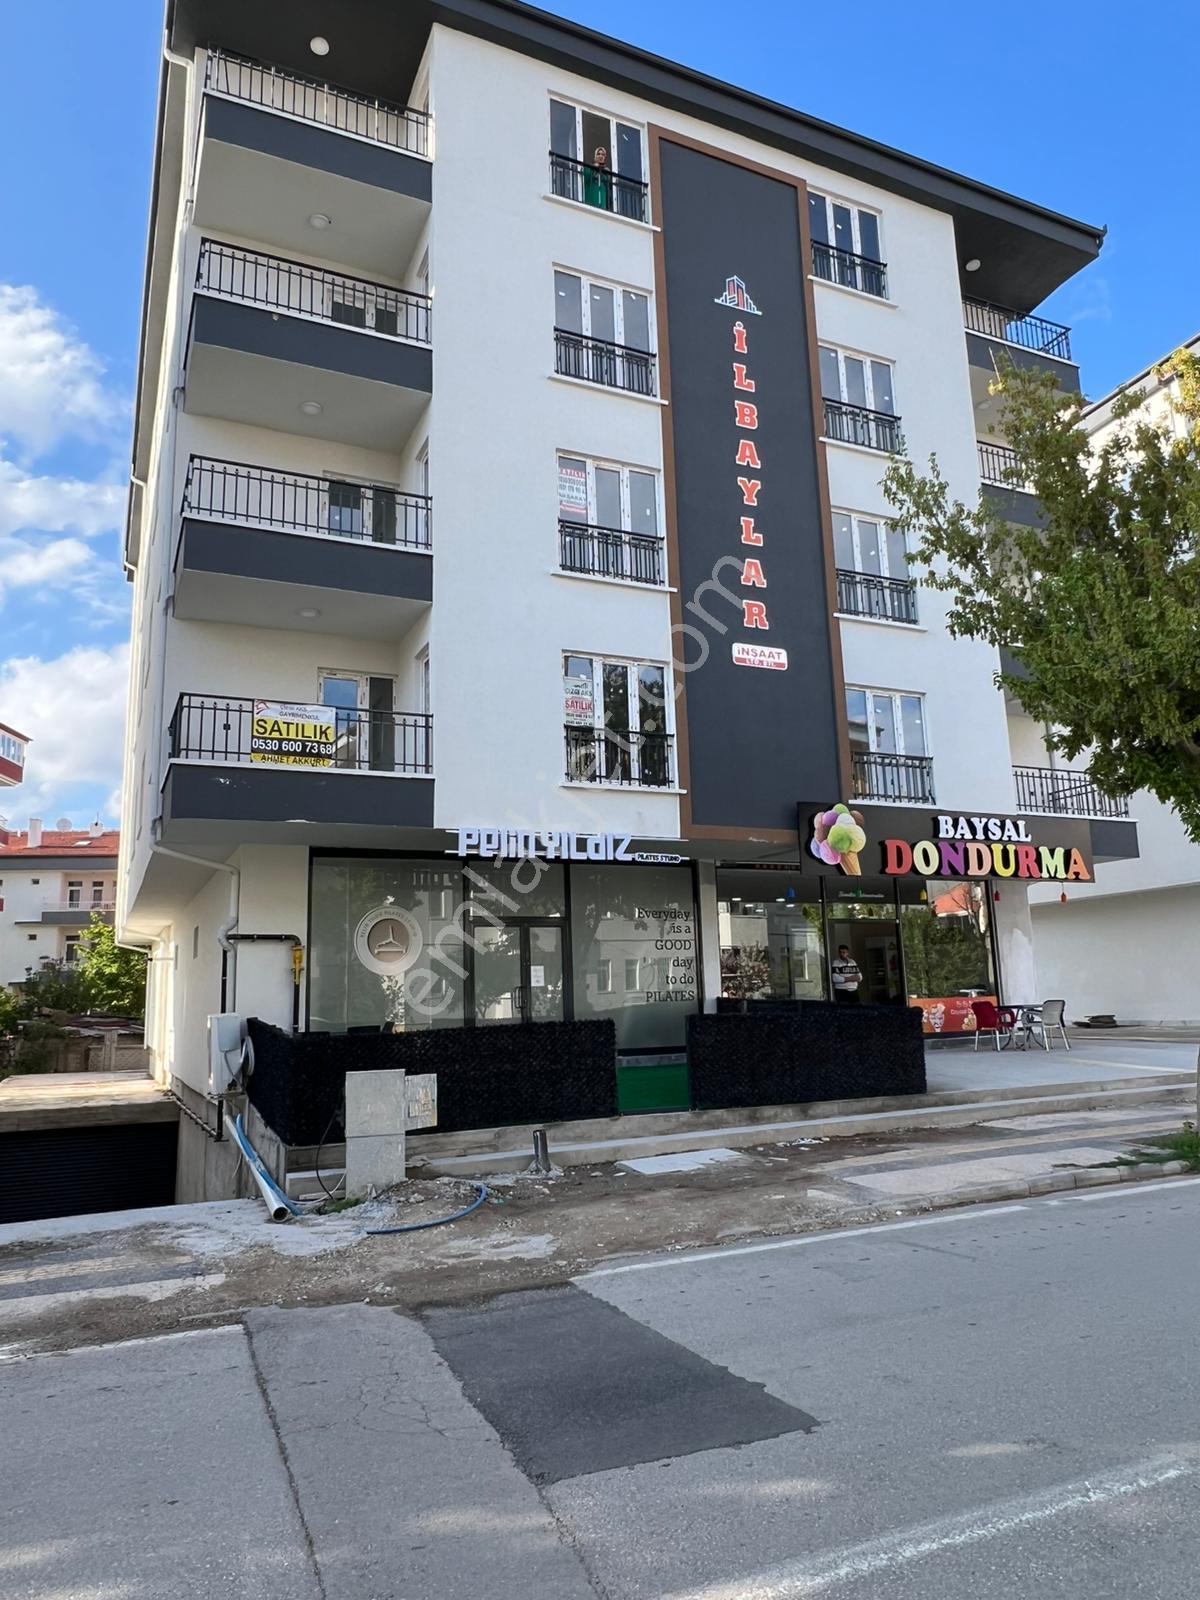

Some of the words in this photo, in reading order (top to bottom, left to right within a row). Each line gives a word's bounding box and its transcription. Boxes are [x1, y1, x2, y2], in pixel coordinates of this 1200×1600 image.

[733, 321, 769, 630] İLBAYLAR
[565, 700, 593, 711] SATILIK
[255, 719, 331, 741] SATILIK
[252, 738, 279, 751] 0530
[282, 741, 302, 752] 600
[305, 742, 318, 753] 73
[320, 744, 332, 755] 68
[937, 815, 1032, 842] BAYSAL
[884, 839, 1091, 880] DONDURMA
[637, 907, 690, 921] Everyday
[672, 923, 682, 933] is
[684, 925, 691, 933] a
[655, 940, 692, 950] GOOD
[672, 956, 693, 969] day
[665, 974, 677, 984] to
[680, 973, 694, 984] do
[646, 991, 695, 1002] PILATES
